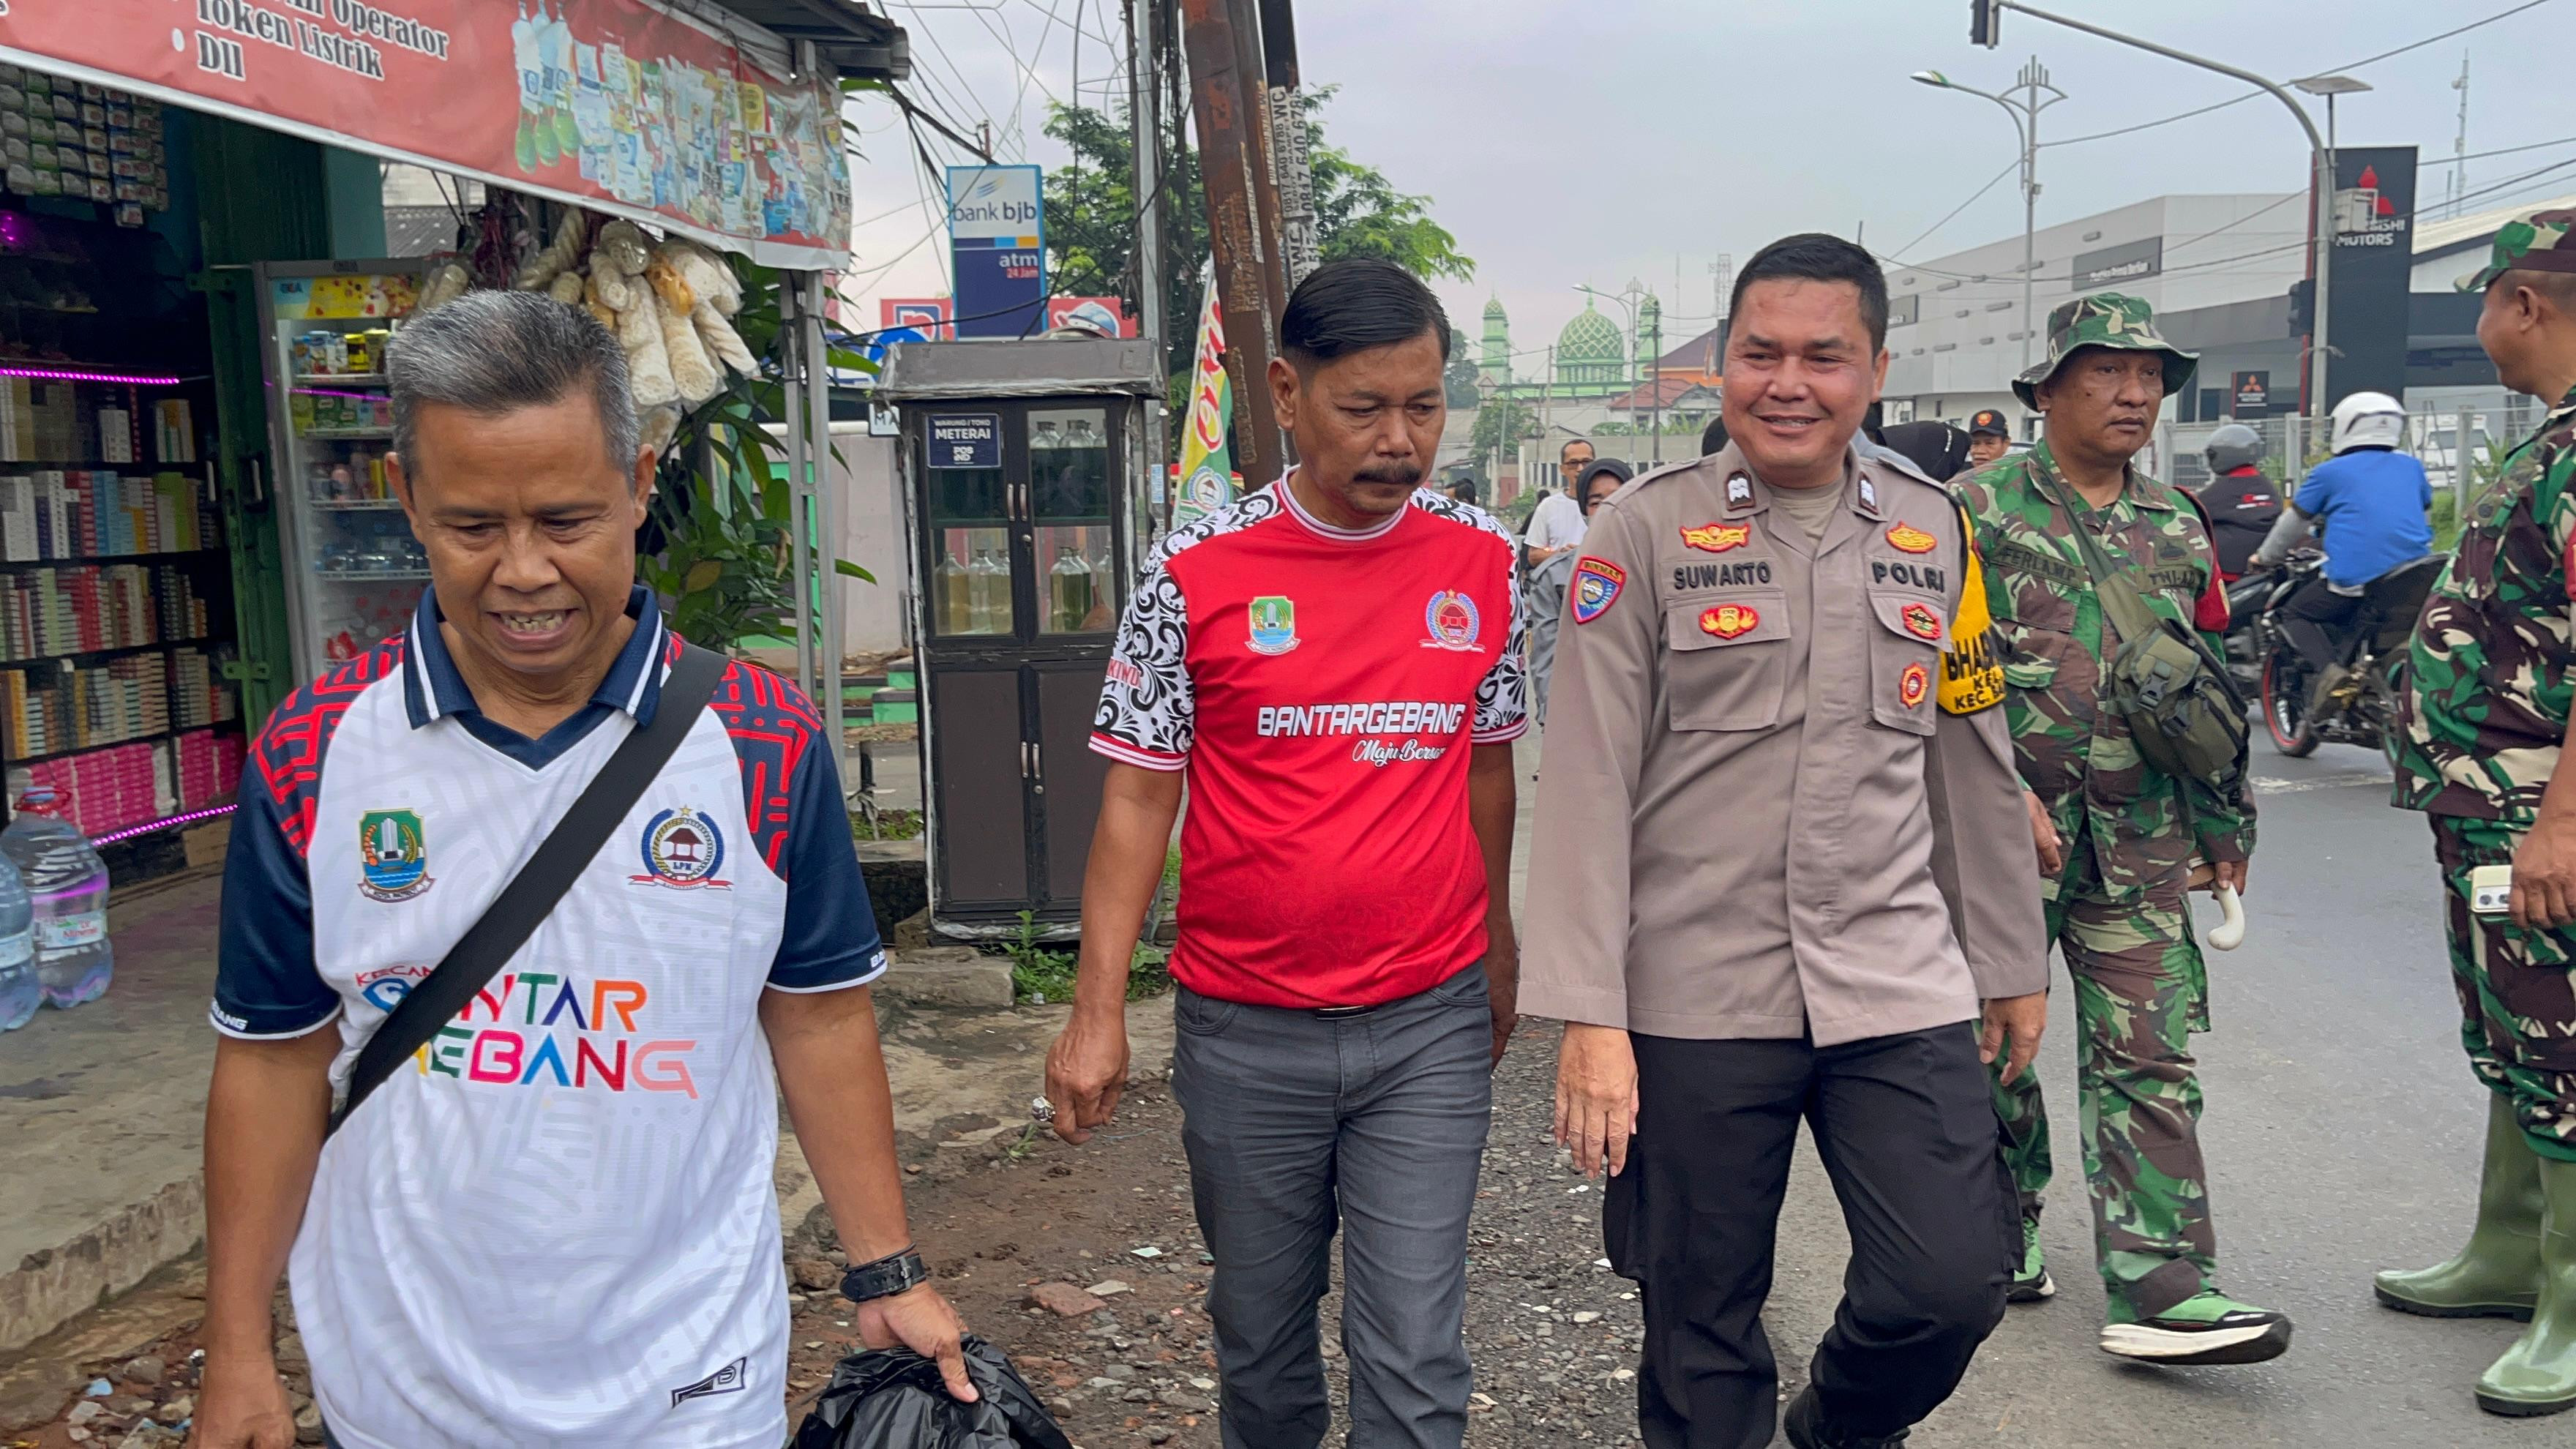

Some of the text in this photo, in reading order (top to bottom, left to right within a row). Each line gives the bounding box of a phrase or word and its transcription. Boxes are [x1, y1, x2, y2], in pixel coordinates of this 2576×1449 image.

[198, 0, 385, 80] Token Listrik
[333, 0, 449, 59] Operator
[195, 30, 245, 81] Dll
[1272, 91, 1288, 120] WC
[952, 201, 1036, 224] bank bjb
[2336, 233, 2395, 247] MOTORS
[999, 252, 1038, 268] atm
[935, 428, 991, 440] METERAI
[954, 446, 974, 454] POS
[1673, 561, 1772, 591] SUWARTO
[1871, 561, 1945, 594] POLRI
[1257, 701, 1467, 738] BANTARGEBANG
[1352, 738, 1399, 768] Maju
[412, 1025, 699, 1100] EBANG
